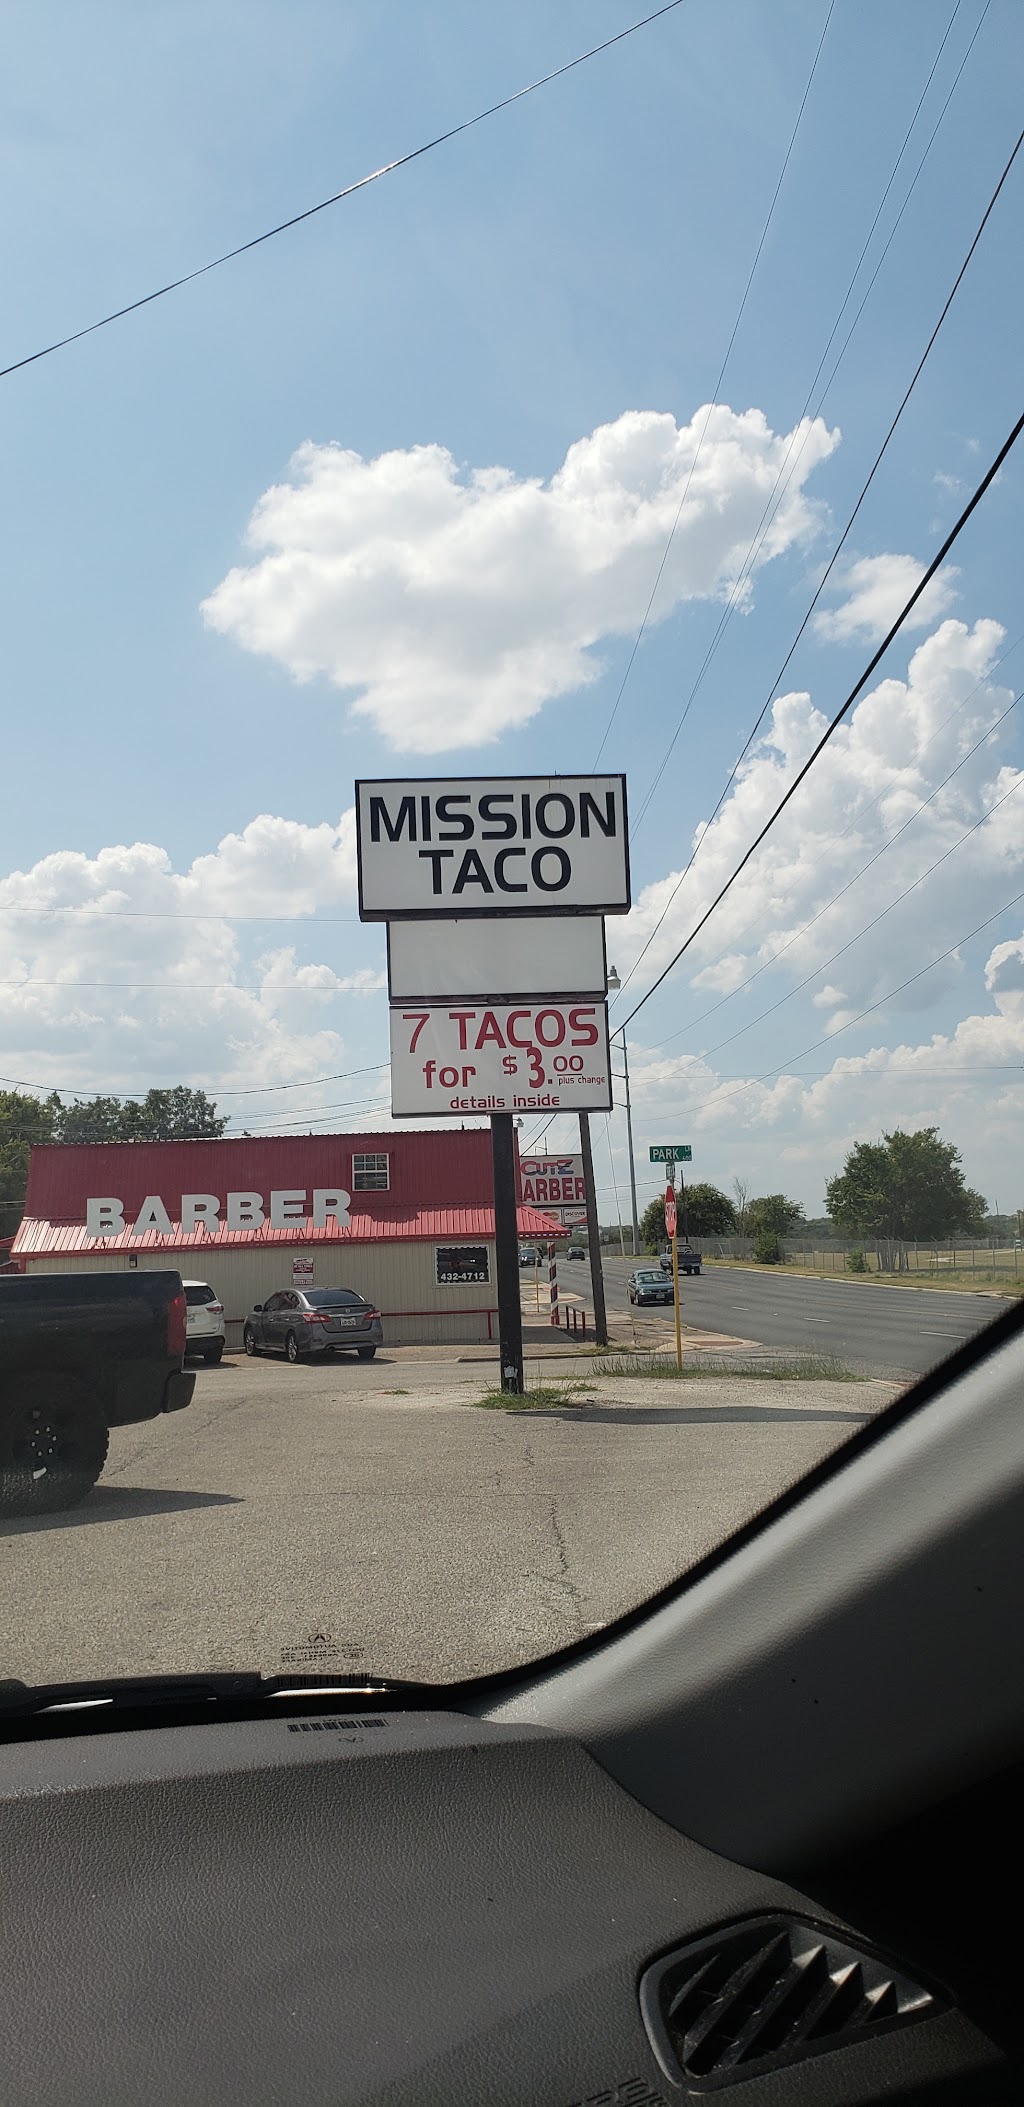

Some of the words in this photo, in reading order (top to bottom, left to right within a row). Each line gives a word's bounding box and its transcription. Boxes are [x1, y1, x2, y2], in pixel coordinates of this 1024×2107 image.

[369, 792, 616, 842] MISSION
[418, 846, 571, 894] TACO
[402, 1013, 430, 1053] 7
[448, 1008, 599, 1050] TACOS
[422, 1060, 476, 1088] for
[558, 1075, 575, 1086] plus
[577, 1073, 605, 1084] change
[450, 1095, 505, 1109] details
[513, 1094, 560, 1106] inside
[652, 1148, 679, 1160] PARK
[523, 1177, 586, 1201] ARBER
[86, 1189, 352, 1238] BARBER
[440, 1272, 485, 1281] 432-4712
